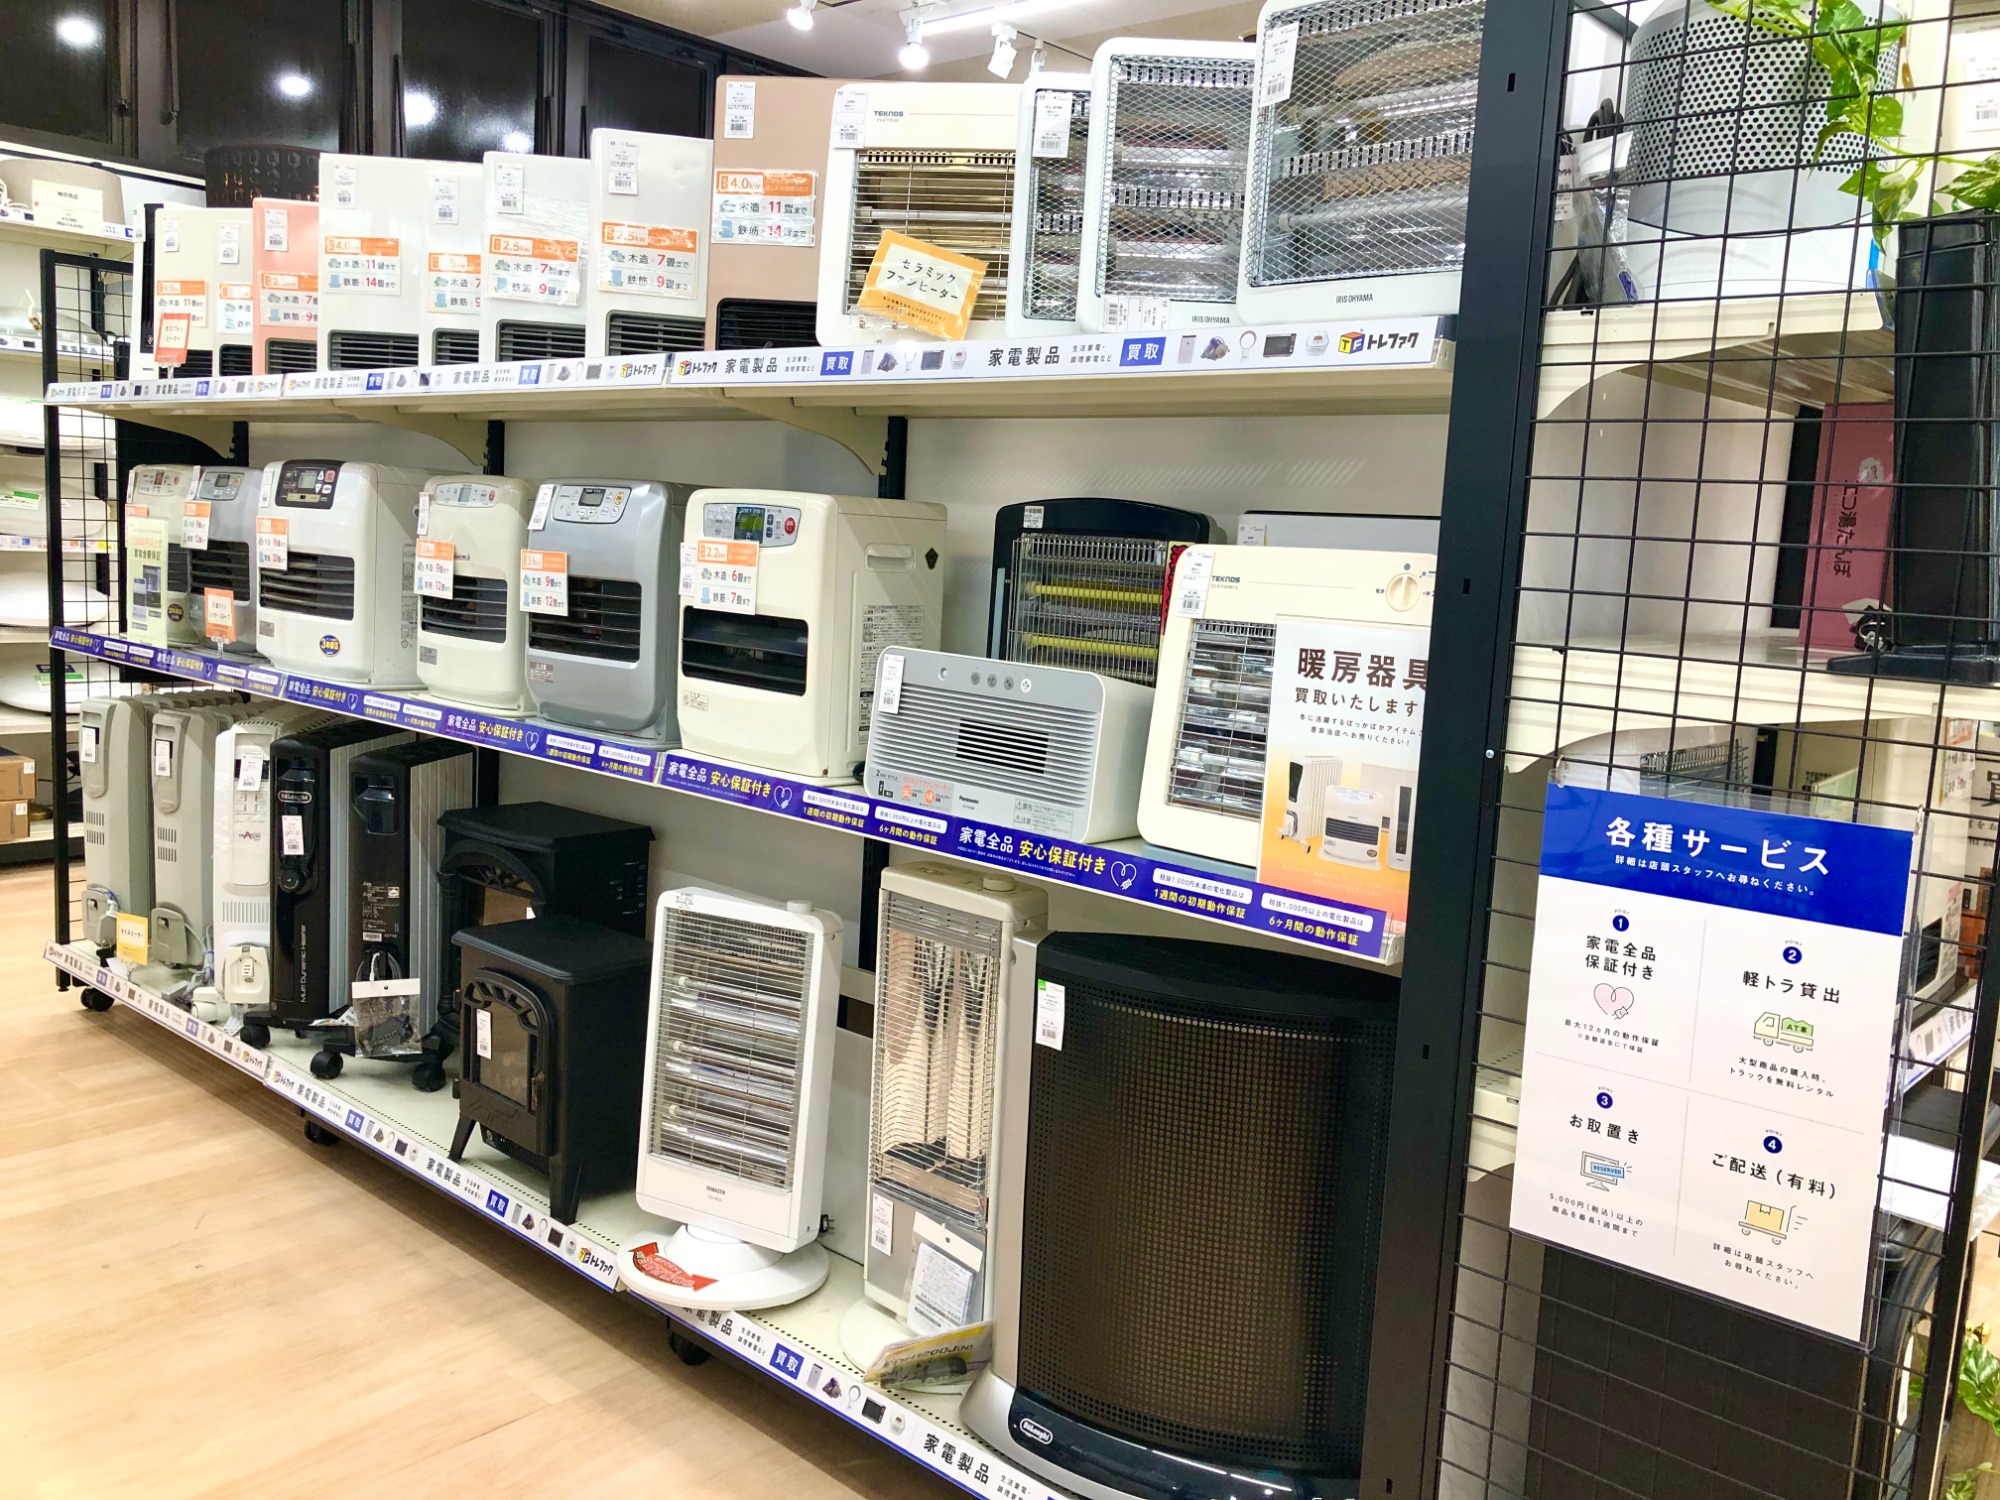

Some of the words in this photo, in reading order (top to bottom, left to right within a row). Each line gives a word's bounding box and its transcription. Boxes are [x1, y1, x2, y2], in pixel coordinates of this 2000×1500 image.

[902, 259, 956, 284] セラミック
[1336, 294, 1347, 304] IRIS
[1348, 293, 1373, 303] OHYAMA
[1208, 316, 1230, 324] OHYAMA
[1128, 343, 1157, 361] 買取
[1367, 332, 1418, 350] トレファク
[692, 361, 717, 373] トレファク
[725, 357, 778, 374] 家電製品
[825, 356, 849, 371] 買取
[989, 347, 1061, 366] 家電製品
[453, 370, 489, 383] 家電製品
[520, 368, 539, 381] 買取
[1212, 575, 1240, 583] TEKNOS
[1297, 647, 1428, 692] 暖房器具
[1295, 688, 1419, 716] 買取いたします
[447, 714, 476, 732] 家電全品
[479, 721, 523, 742] 安心保証付き
[668, 761, 707, 783] 家電全品
[711, 771, 771, 798] 安心保証付き
[803, 807, 864, 828] 1週間の初期動作保証
[959, 826, 1014, 854] 家電全品
[1019, 840, 1107, 875] 安心保証付き
[1605, 816, 1830, 875] 各種サービス
[1615, 854, 1816, 896] 詳細は店頭スタッフへお尋ねください。
[1154, 888, 1246, 919] 1週間の初期動作保証
[1586, 935, 1656, 961] 家電全品
[1585, 954, 1654, 980] 保証付き
[1743, 971, 1840, 1004] 軽トラ貸出
[1730, 1067, 1834, 1098] トラックを無料レンタル
[1739, 1056, 1826, 1083] 大型商品の購入時、
[297, 1084, 325, 1109] 家電製品
[1569, 1114, 1639, 1144] お取置き
[426, 1157, 461, 1187] 家電製品
[1593, 1164, 1622, 1175] RESERVED
[1712, 1152, 1836, 1199] ご配送(有料)
[489, 1193, 506, 1211] 買取
[1552, 1205, 1638, 1237] 商品を最長1週間まで
[590, 1255, 614, 1276] トレファク
[1712, 1242, 1814, 1280] 詳細は店舗スタッフへ
[1724, 1259, 1799, 1289] お尋ねください。
[775, 1350, 799, 1373] 買取
[923, 1433, 990, 1485] 家電製品
